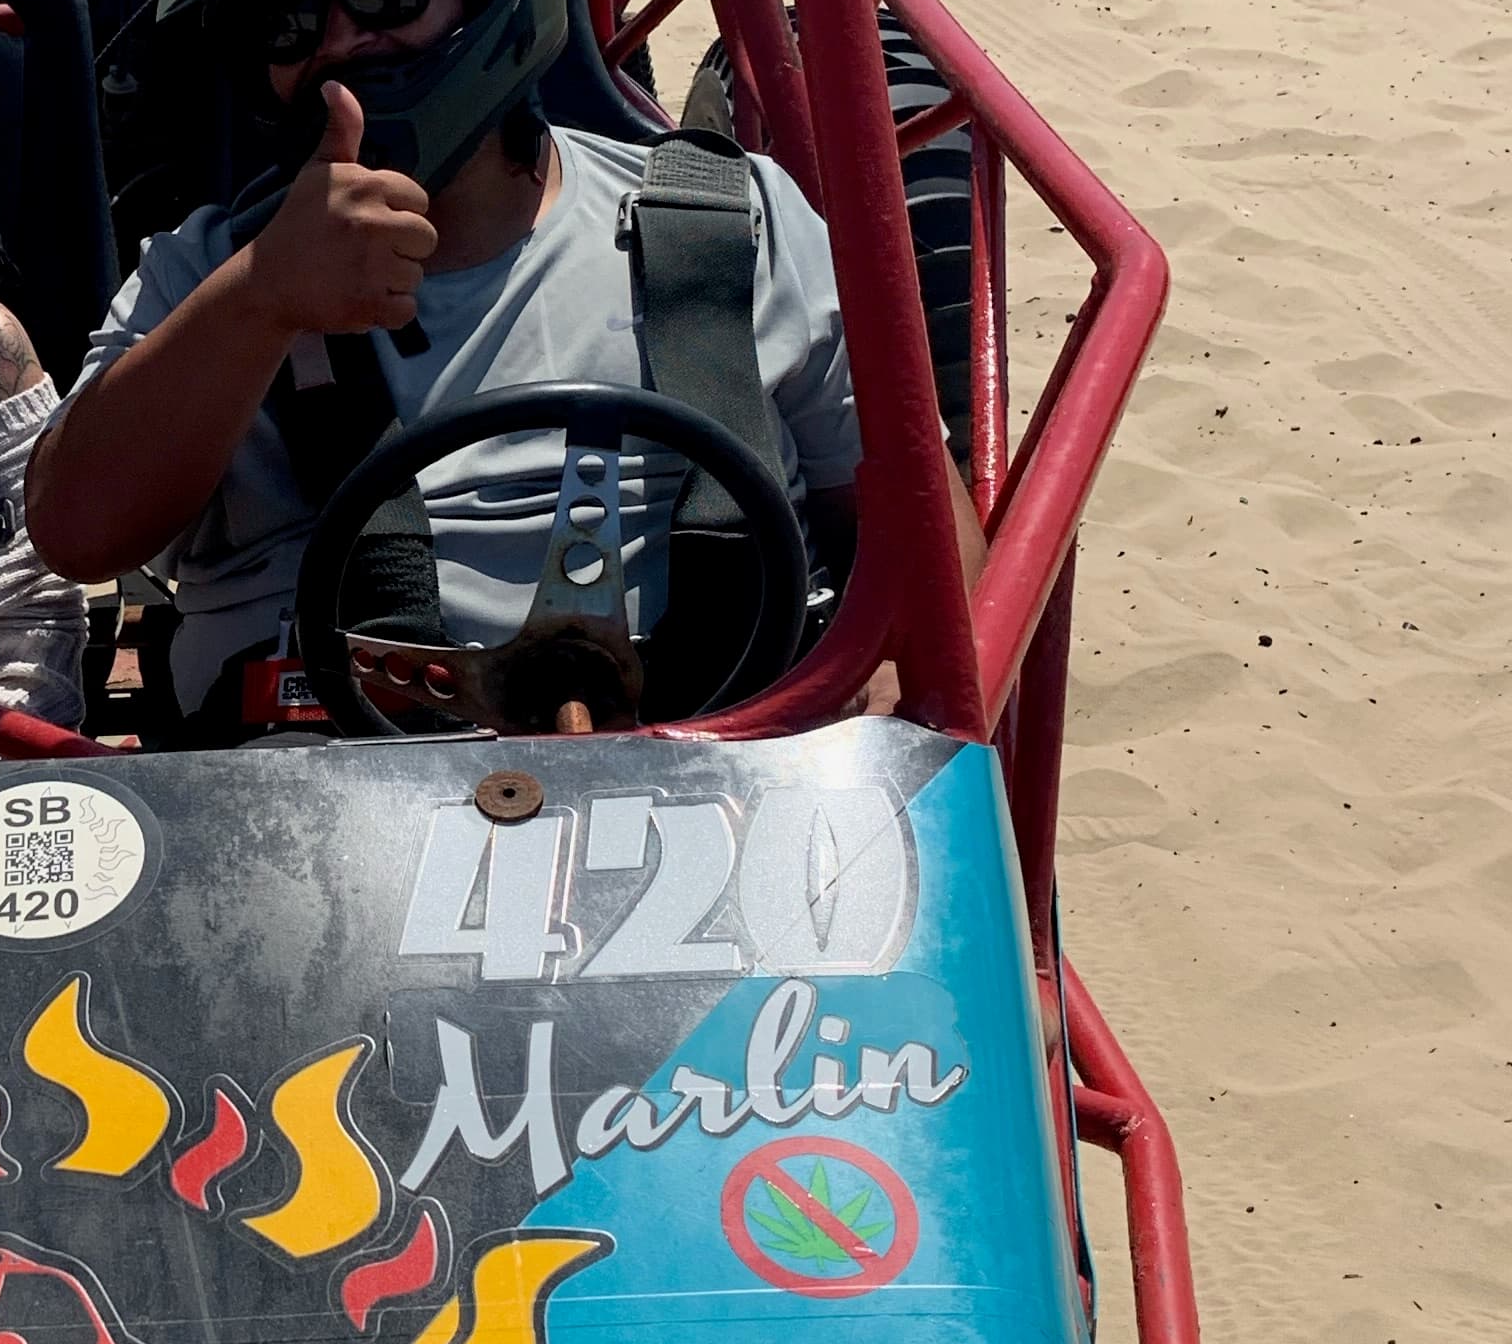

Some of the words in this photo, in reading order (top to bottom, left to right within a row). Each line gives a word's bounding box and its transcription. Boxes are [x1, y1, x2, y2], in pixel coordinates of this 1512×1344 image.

[4, 796, 72, 827] SB
[399, 778, 918, 982] 420
[398, 978, 970, 1199] Marlin
